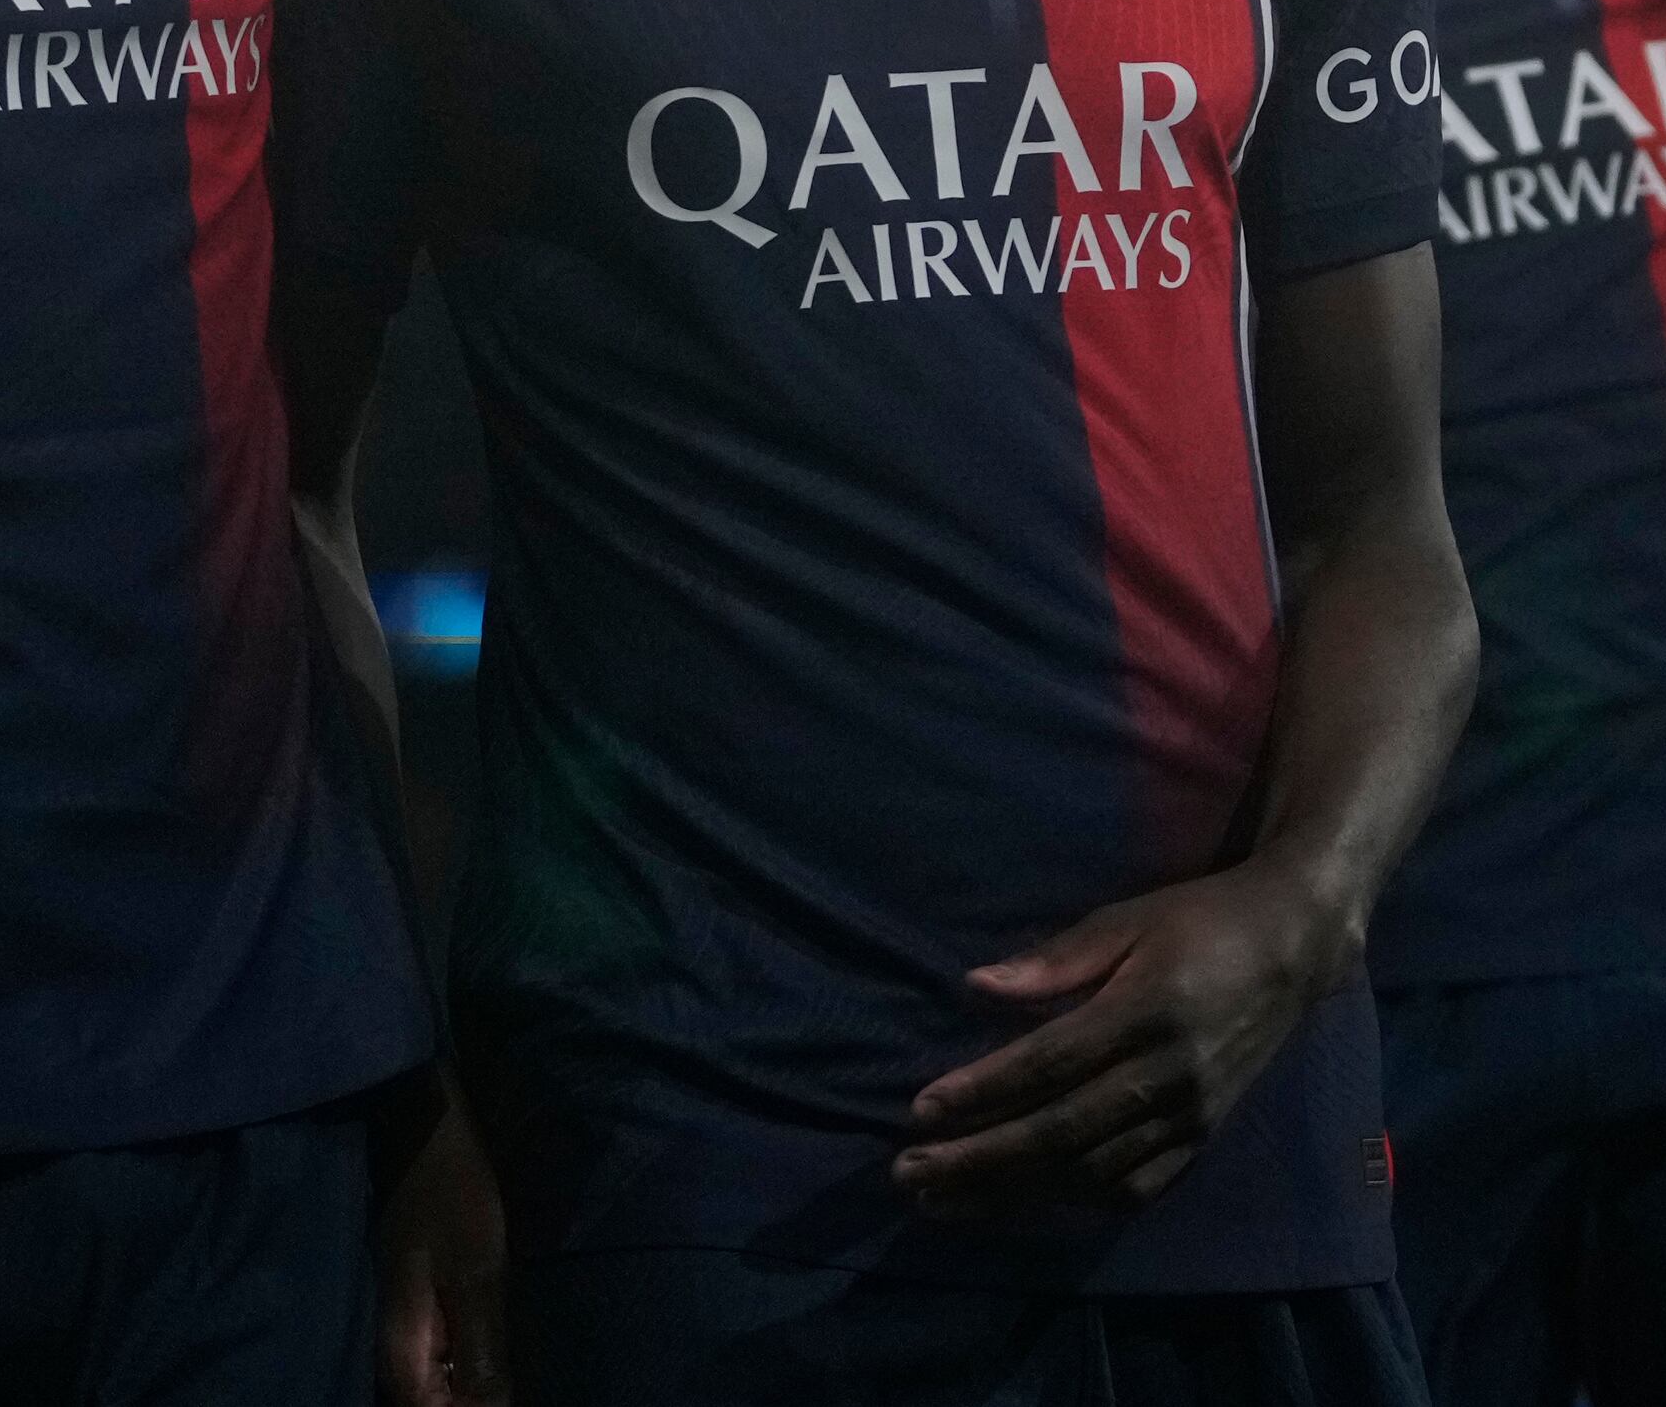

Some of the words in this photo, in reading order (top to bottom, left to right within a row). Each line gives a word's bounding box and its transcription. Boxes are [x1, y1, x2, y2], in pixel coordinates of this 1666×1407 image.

[1316, 30, 1441, 123] GO
[626, 61, 1197, 249] QATAR
[799, 209, 1191, 309] AIRWAYS
